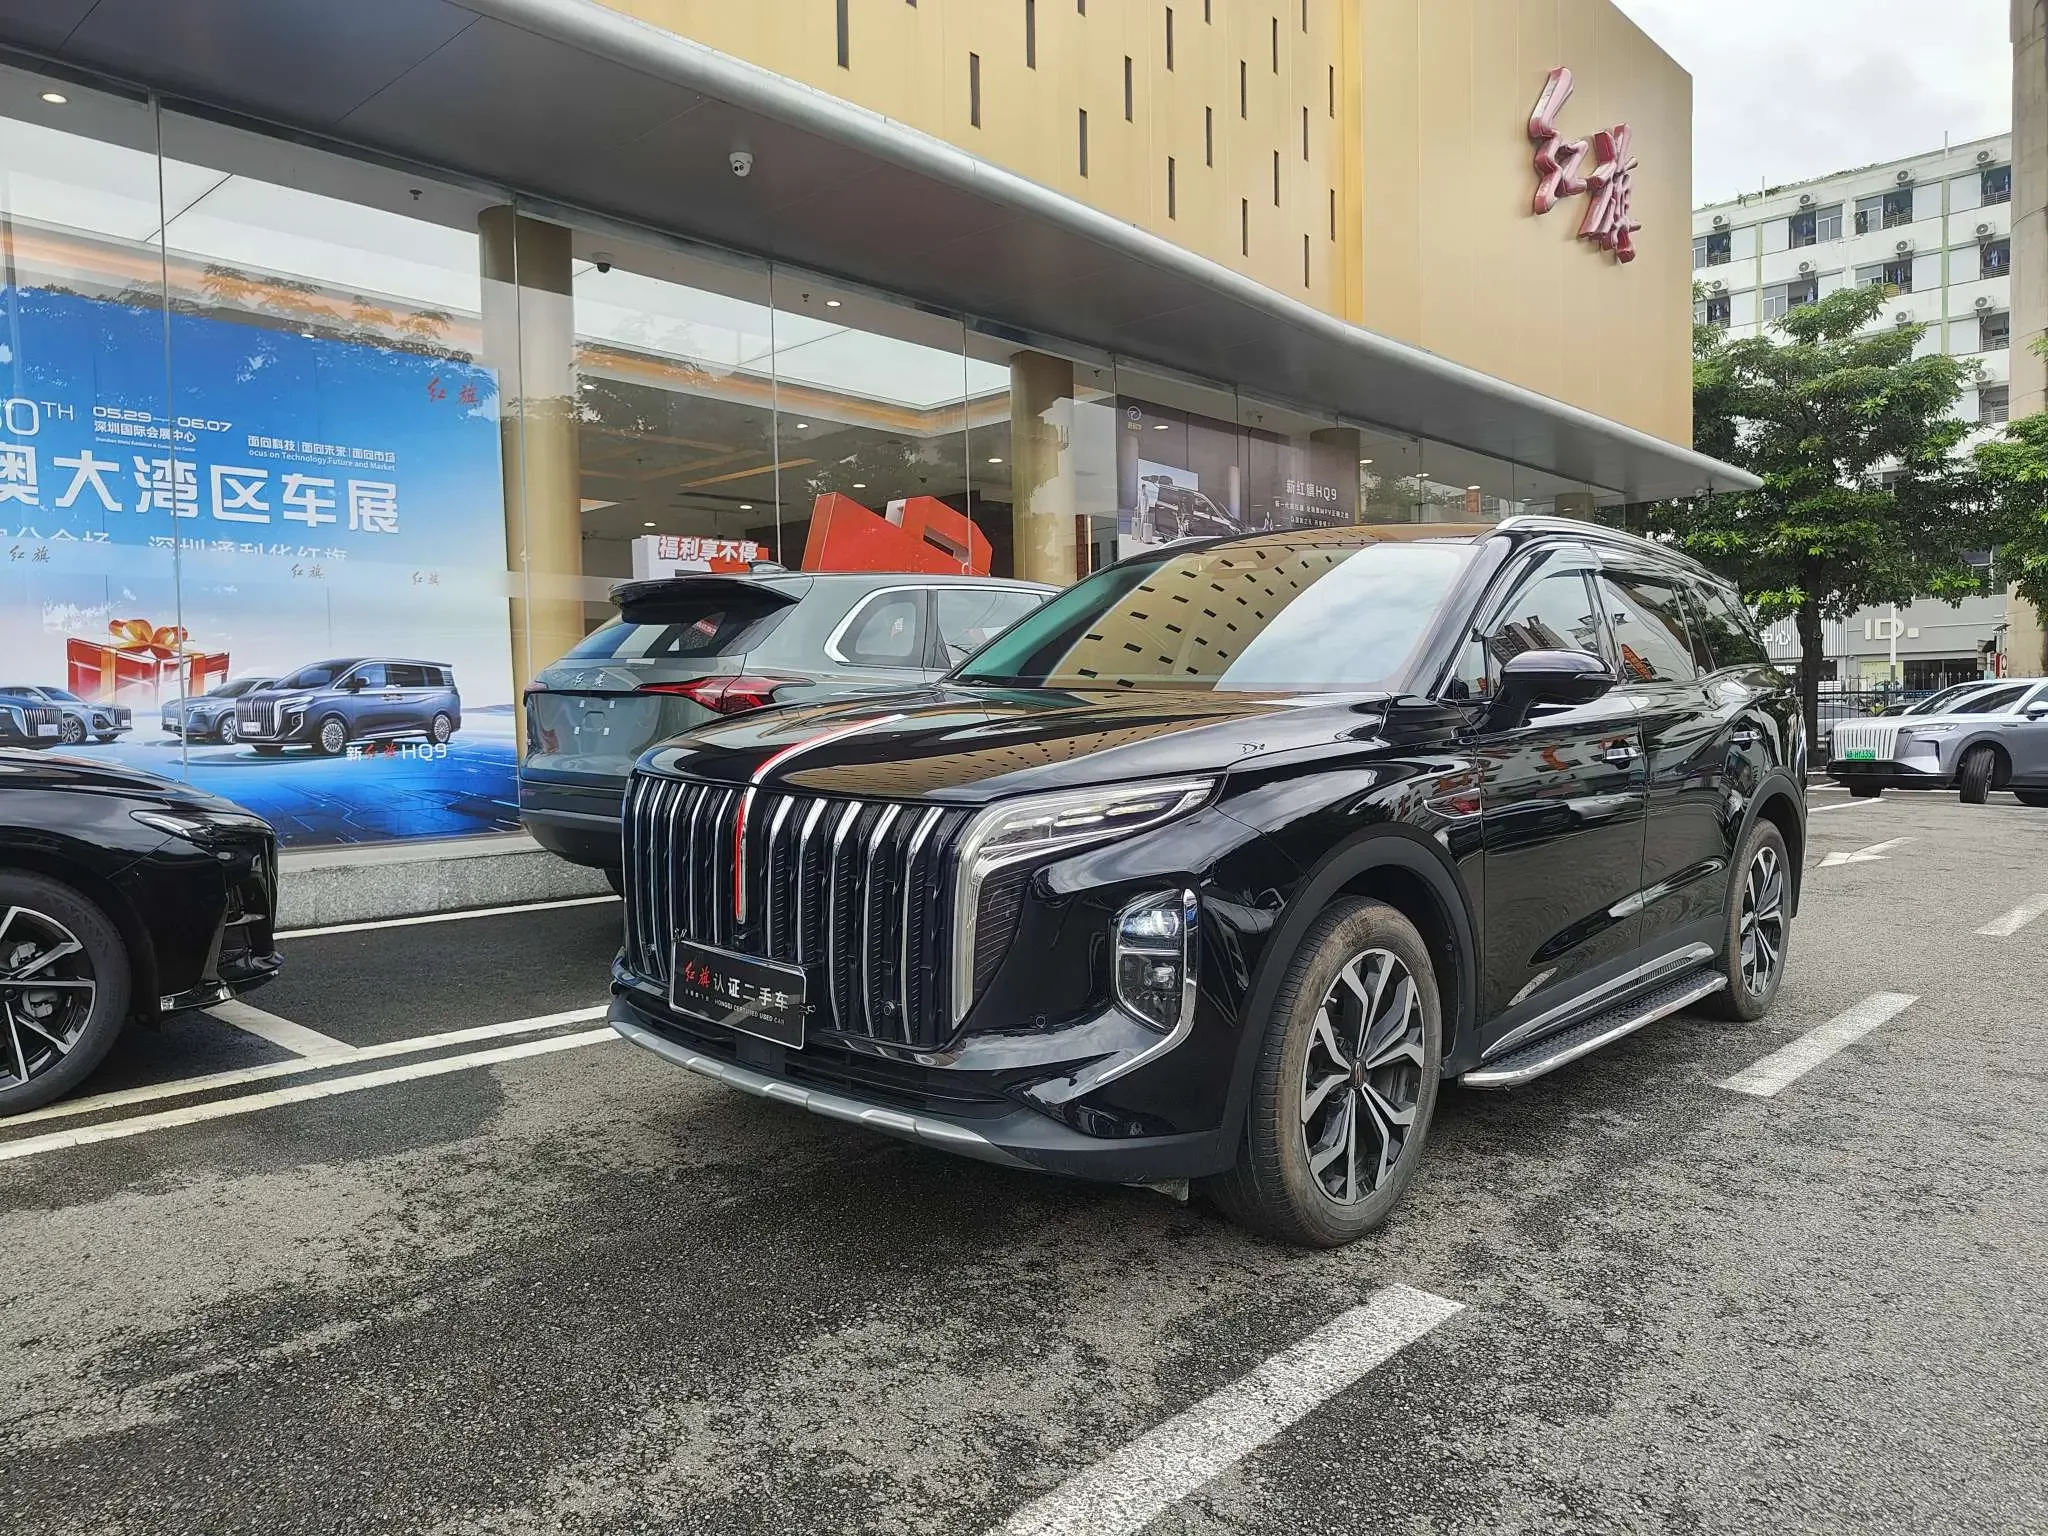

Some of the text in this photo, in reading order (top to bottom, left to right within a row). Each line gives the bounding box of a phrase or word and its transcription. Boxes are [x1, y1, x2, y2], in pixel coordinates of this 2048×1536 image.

[1528, 66, 1642, 264] 红旗
[427, 376, 480, 405] 红旗
[0, 398, 74, 436] 0TH
[94, 420, 197, 443] 深圳国际会展中心
[269, 451, 280, 459] on
[354, 459, 368, 469] and
[370, 462, 396, 472] Market
[9, 545, 50, 563] 红旗
[659, 535, 758, 562] 福利享不停
[291, 563, 325, 579] 红旗
